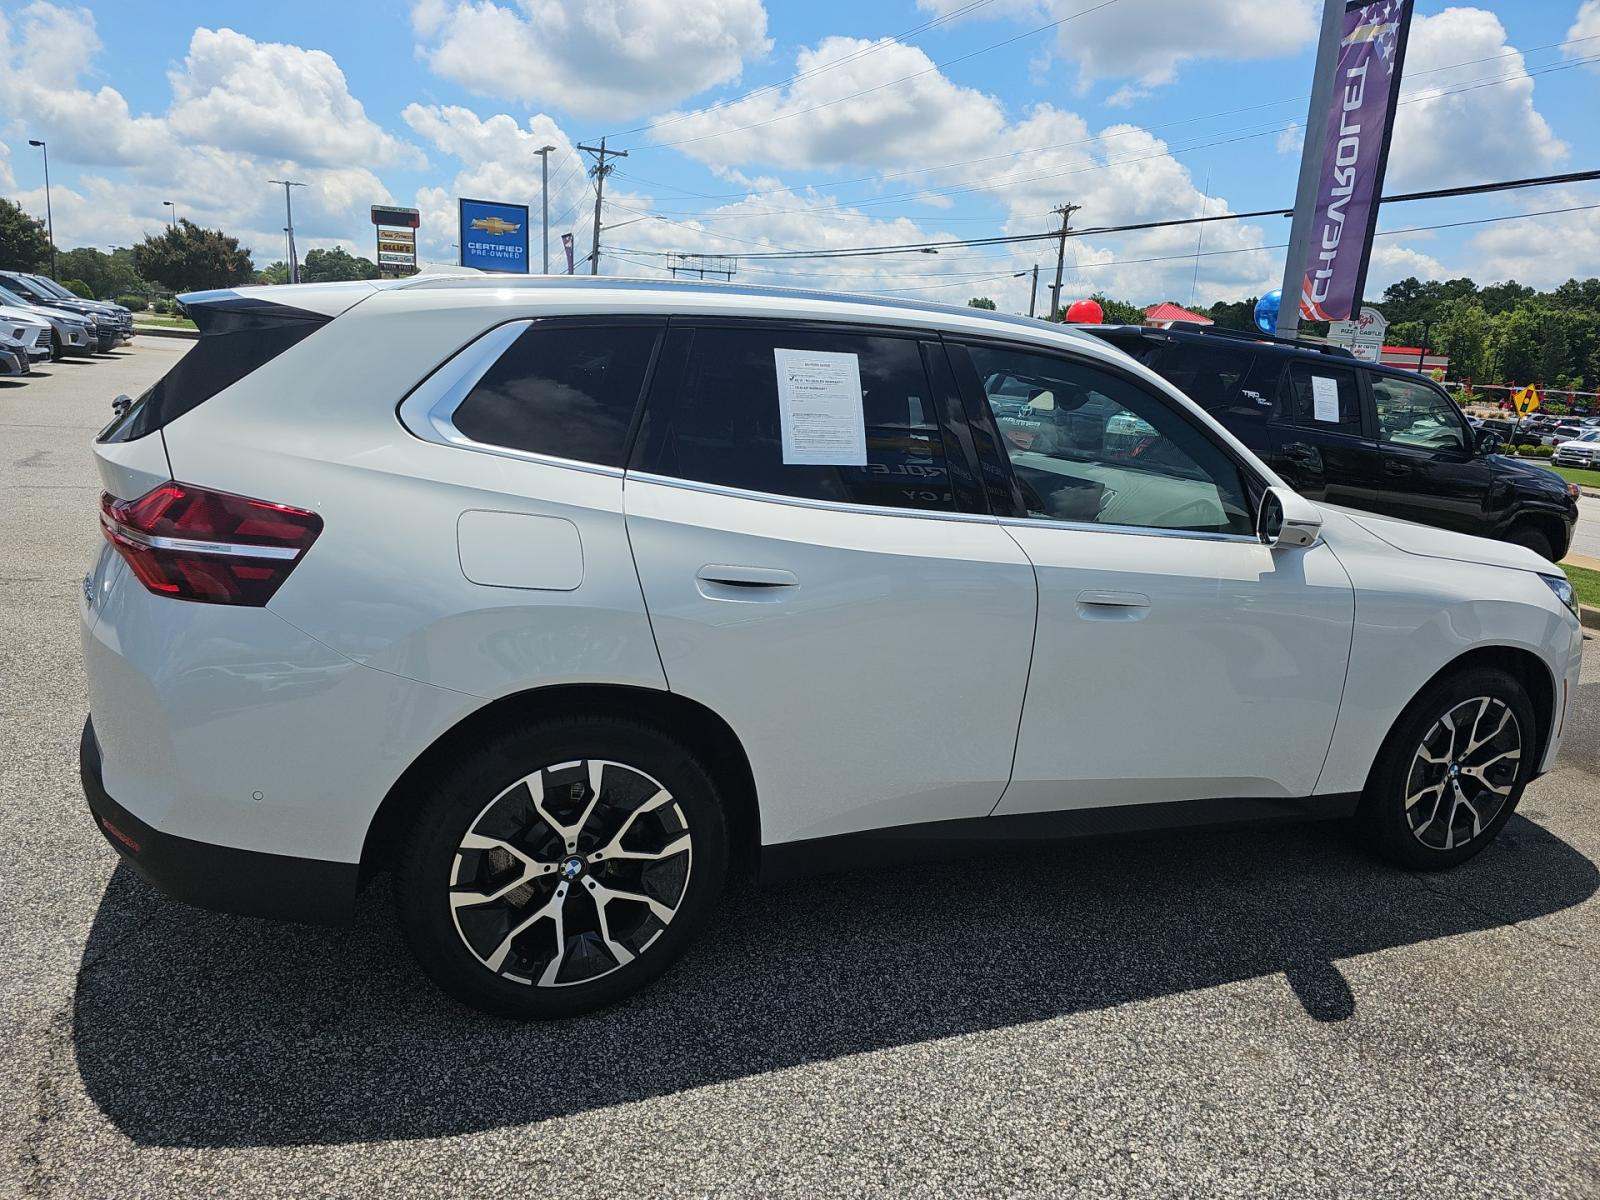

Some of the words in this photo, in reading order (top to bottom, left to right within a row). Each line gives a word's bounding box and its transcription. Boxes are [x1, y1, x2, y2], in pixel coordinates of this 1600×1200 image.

[468, 242, 523, 254] CERTIFIED
[471, 249, 520, 259] PRE-OWNED
[1241, 389, 1260, 399] TRD
